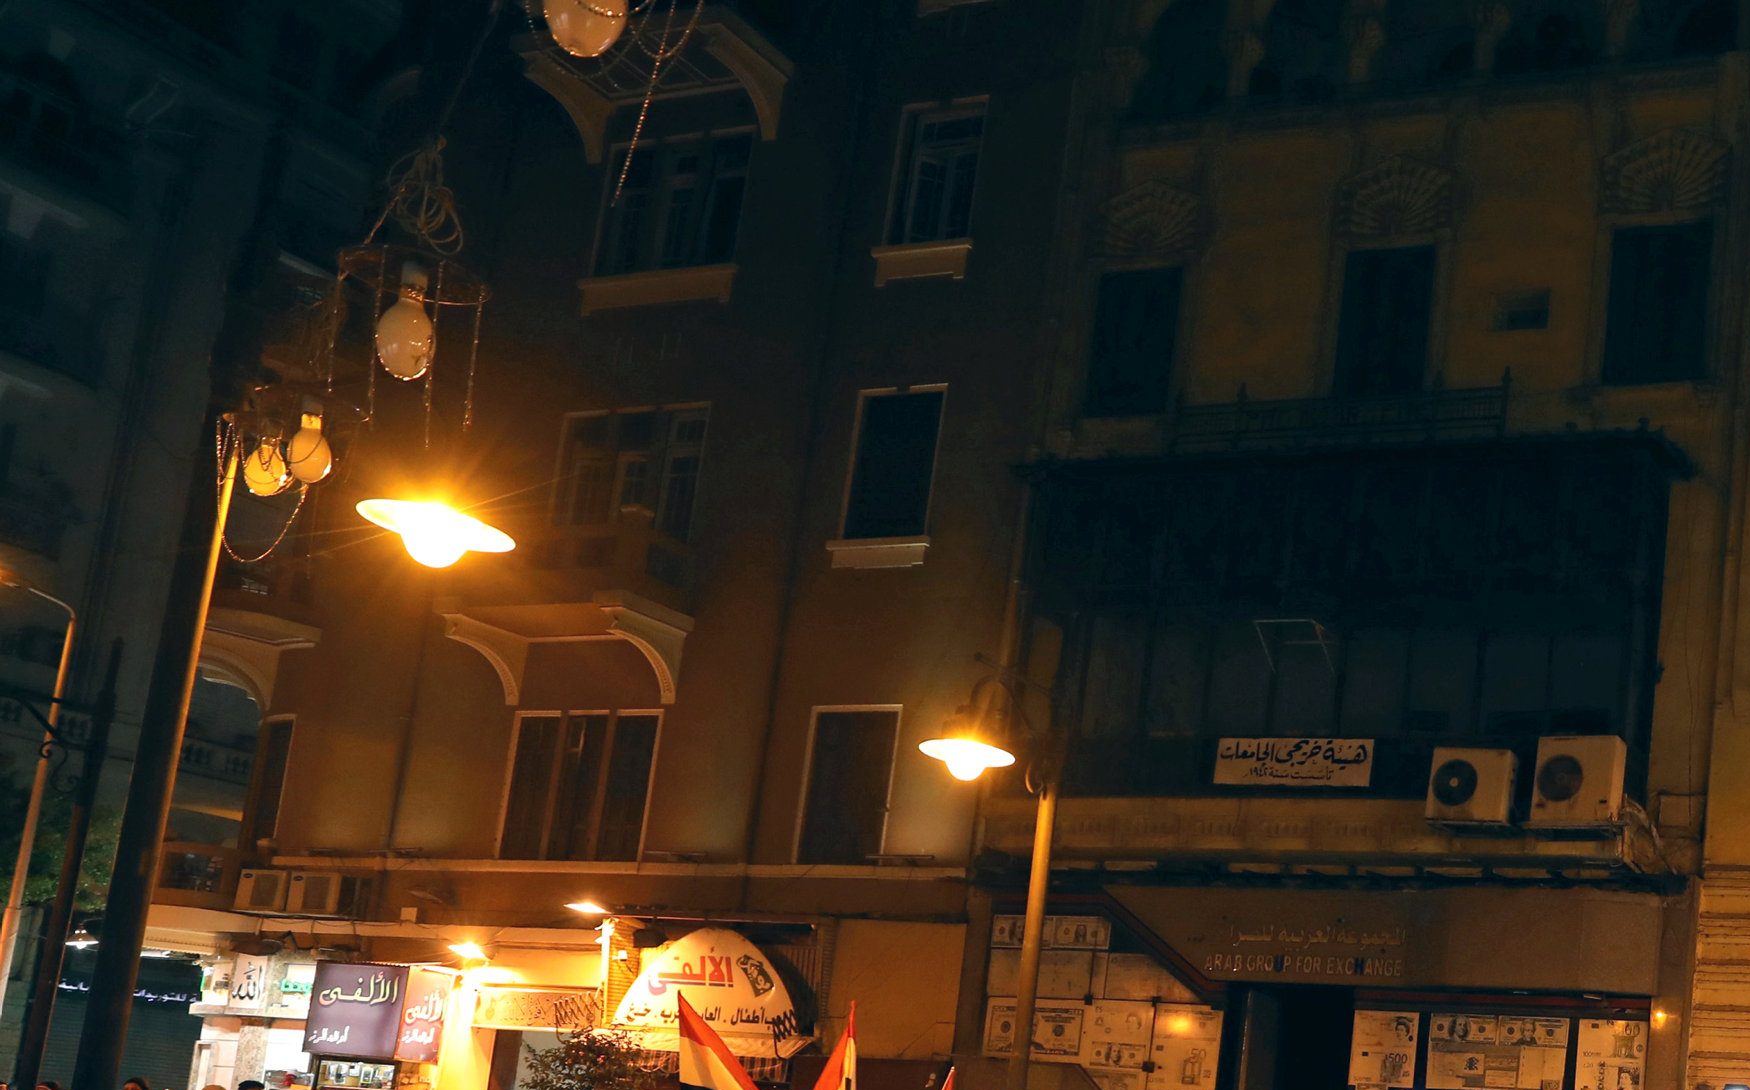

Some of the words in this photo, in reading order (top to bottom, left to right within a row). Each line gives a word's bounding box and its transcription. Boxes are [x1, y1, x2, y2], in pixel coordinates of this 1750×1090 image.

[1204, 953, 1243, 971] ARAB
[1246, 954, 1292, 972] GROUP
[1296, 955, 1321, 974] FOR
[1326, 957, 1402, 977] EXCHANGE
[700, 1006, 721, 1022] العا
